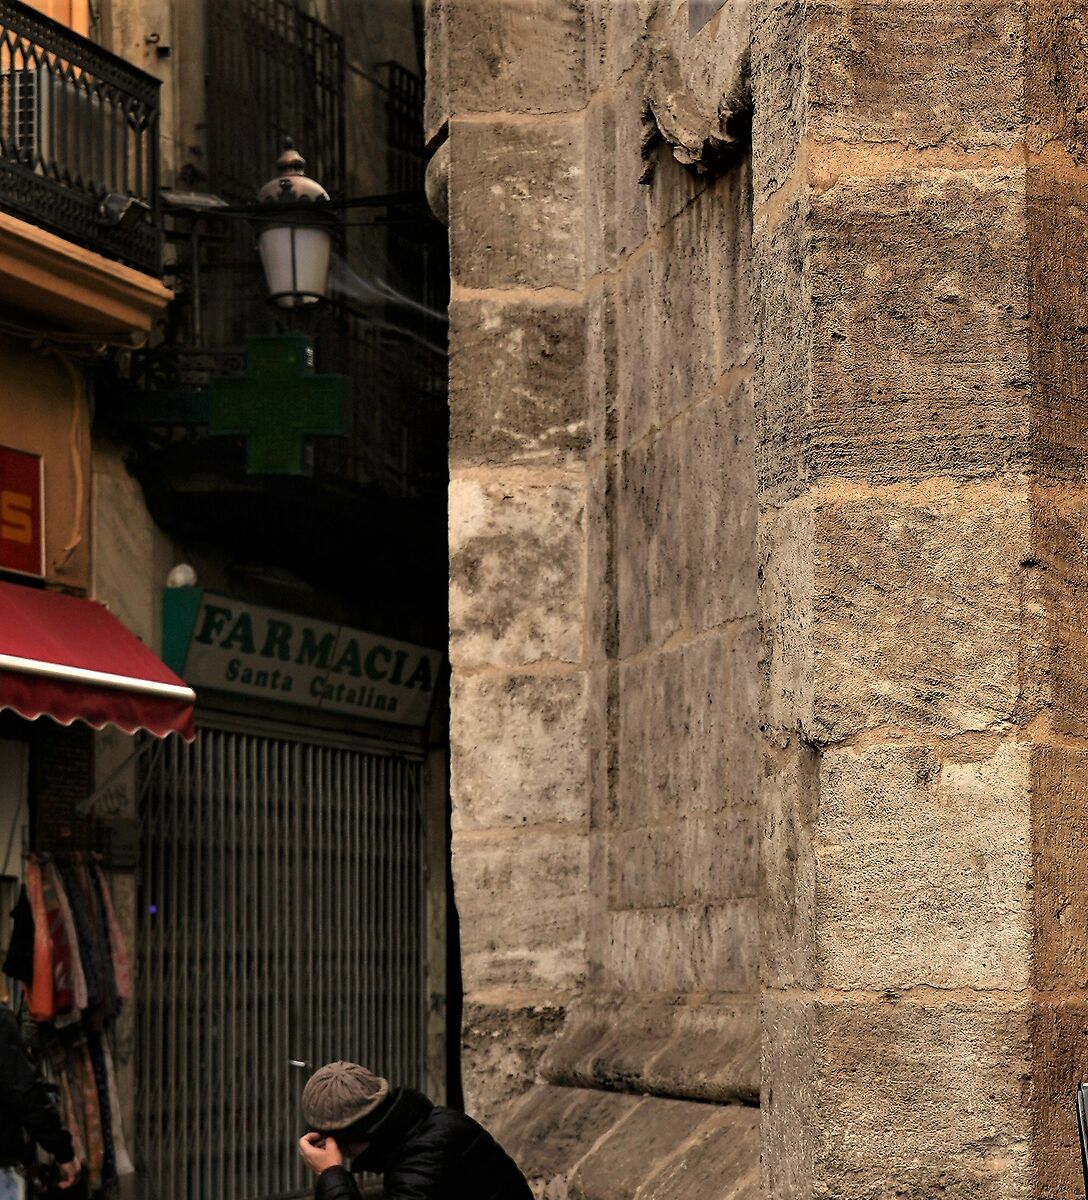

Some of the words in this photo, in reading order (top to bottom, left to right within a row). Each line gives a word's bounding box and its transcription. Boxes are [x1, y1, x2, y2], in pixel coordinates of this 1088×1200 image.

[195, 605, 433, 691] FARMACIA
[225, 658, 293, 691] Santa
[309, 676, 398, 713] Catalina
